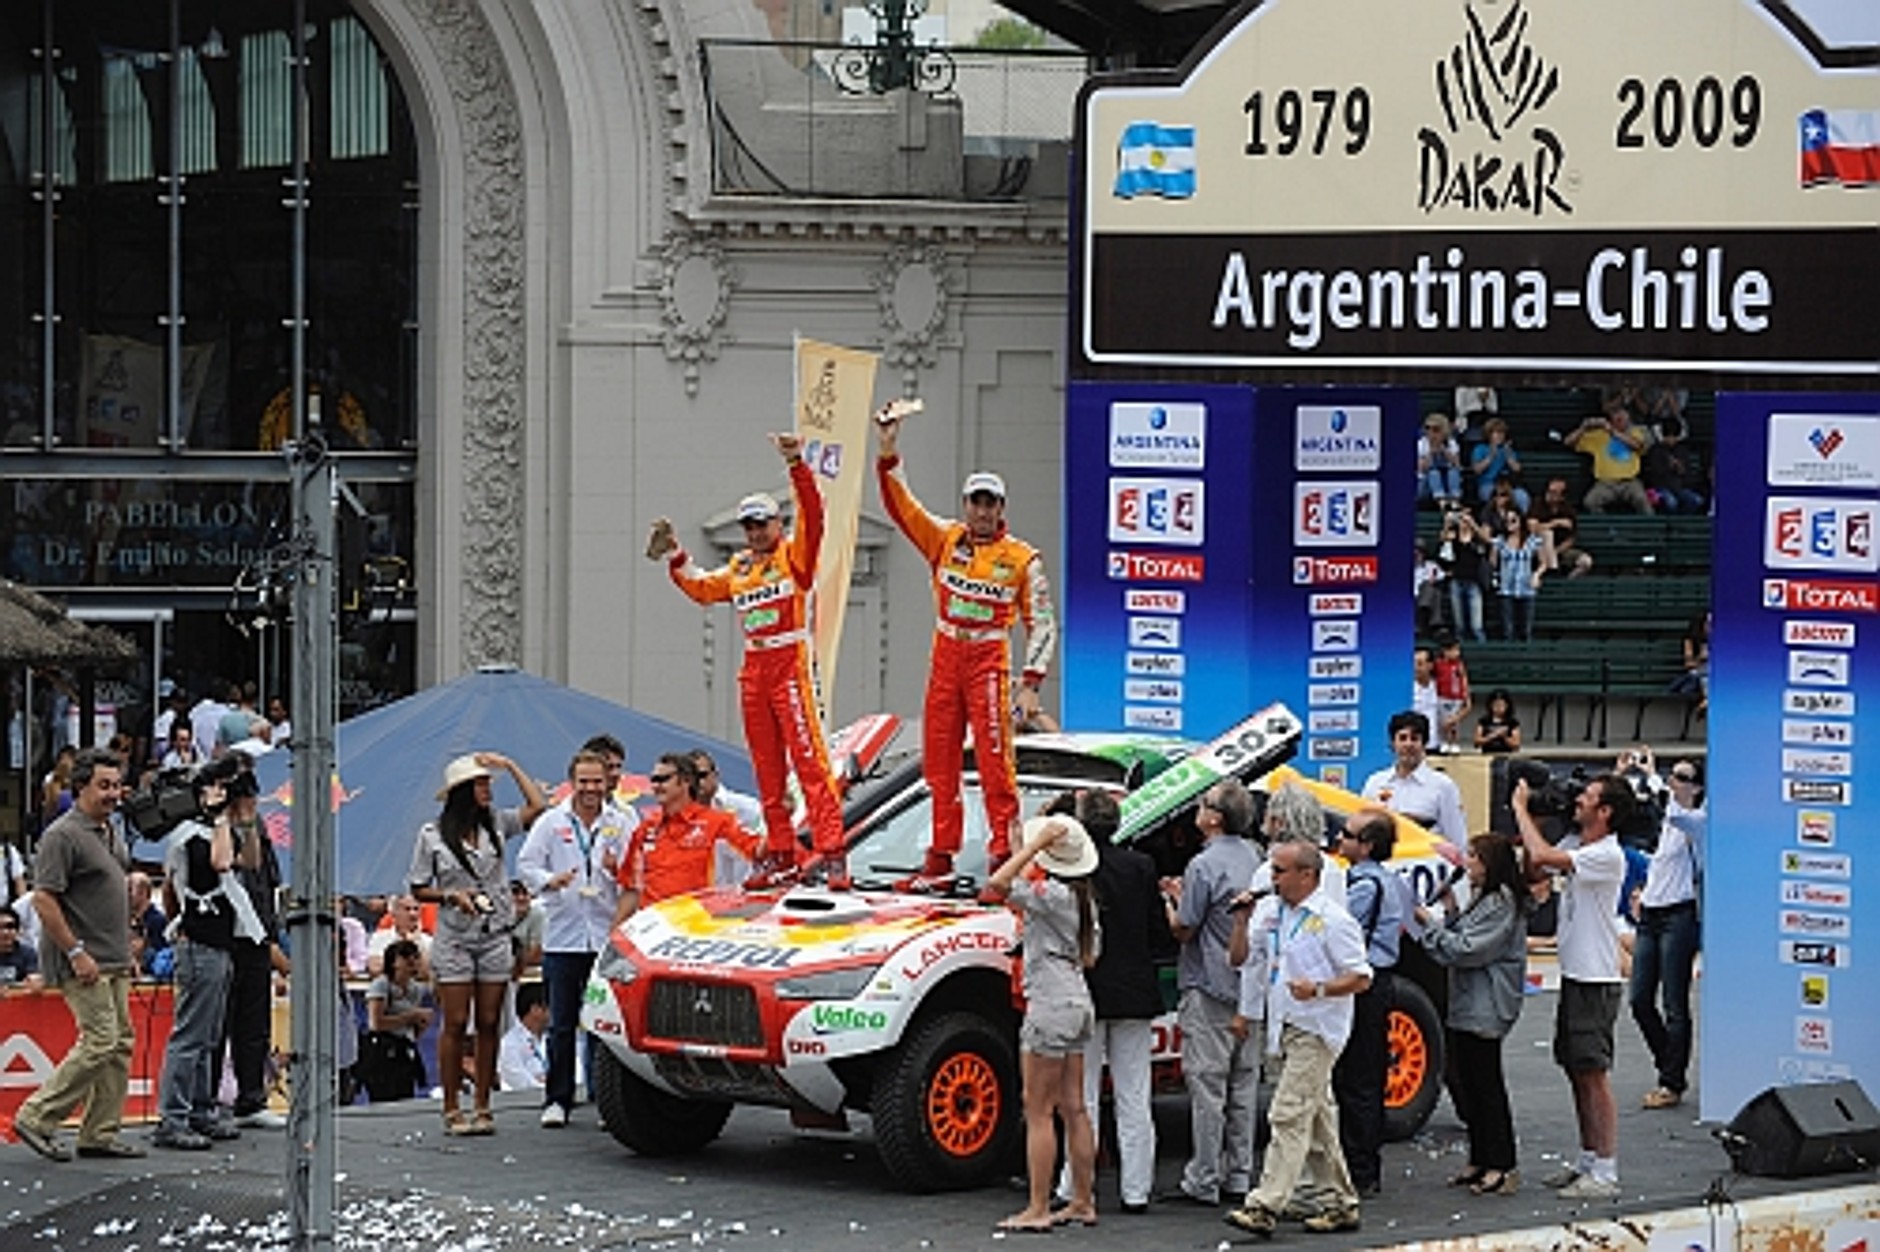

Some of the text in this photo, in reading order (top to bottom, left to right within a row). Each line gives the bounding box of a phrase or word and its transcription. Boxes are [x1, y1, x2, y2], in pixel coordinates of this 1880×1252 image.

[1244, 86, 1371, 156] 1979
[1616, 75, 1763, 148] 2009
[1417, 127, 1573, 215] DAKAR
[1212, 247, 1772, 349] Argentina-Chile
[1113, 435, 1201, 449] ARGENTINA
[1301, 438, 1376, 452] ARGENTINA
